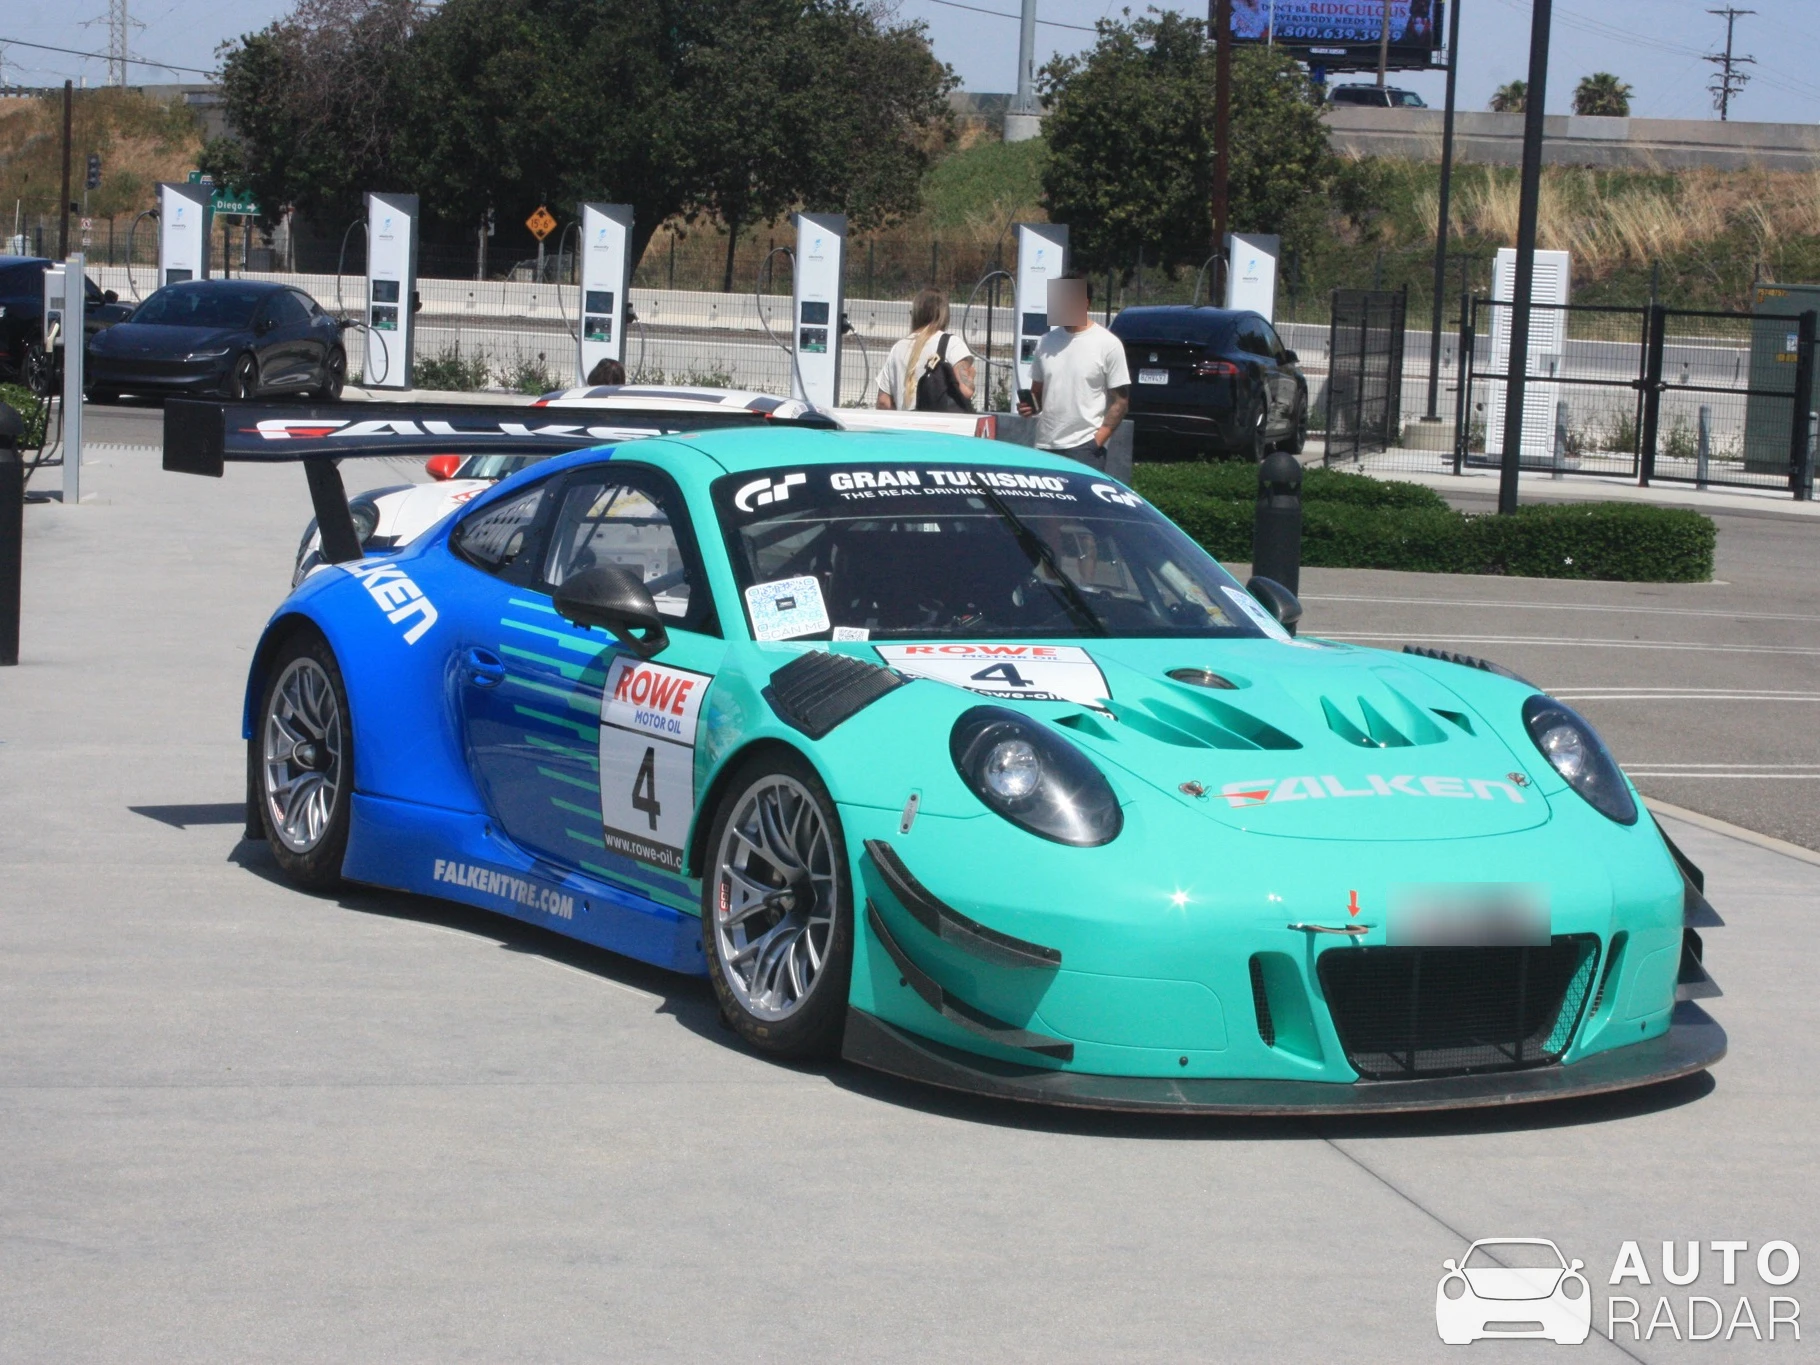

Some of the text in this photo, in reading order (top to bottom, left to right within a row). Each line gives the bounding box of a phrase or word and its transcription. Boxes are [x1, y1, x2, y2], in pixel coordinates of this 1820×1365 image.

[217, 201, 243, 212] Diego
[256, 418, 681, 441] FALKE
[830, 471, 921, 490] GRAN
[840, 490, 876, 500] THE
[878, 488, 922, 497] REAL
[994, 488, 1078, 501] SIMULATOR
[761, 621, 827, 641] SCAN ME
[905, 645, 1056, 656] ROWE
[970, 662, 1035, 687] 4
[613, 664, 695, 717] ROWE
[634, 709, 682, 735] MOTOR OIL
[632, 746, 661, 832] 4
[1220, 774, 1527, 808] FALKEN
[433, 859, 574, 920] FALKENTYRE.COM
